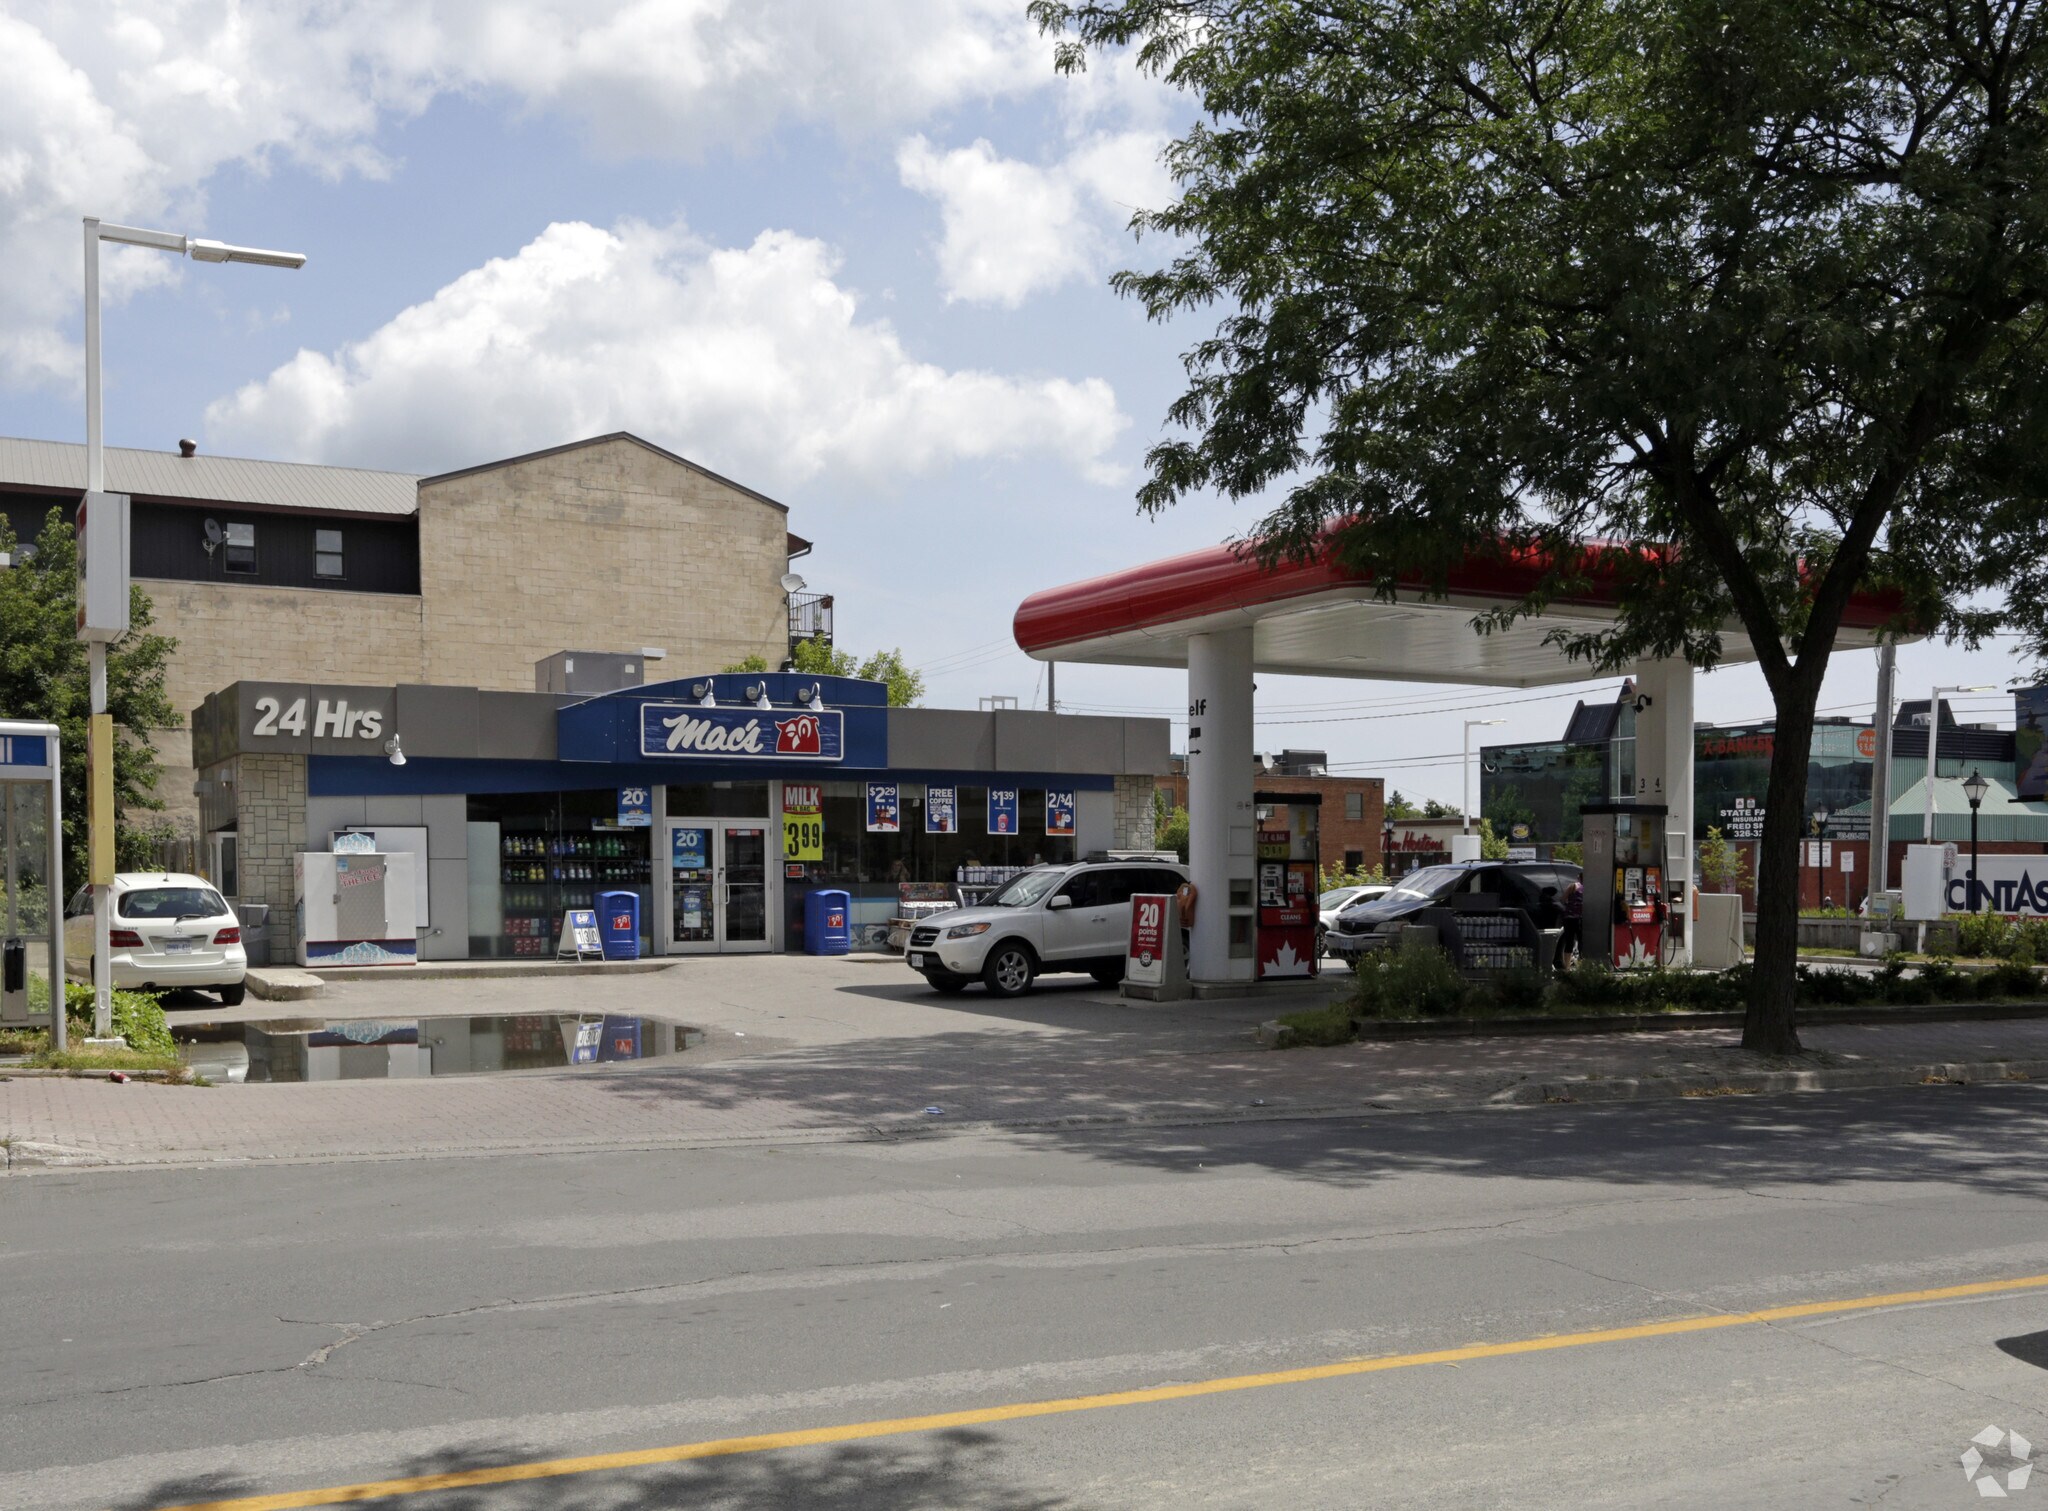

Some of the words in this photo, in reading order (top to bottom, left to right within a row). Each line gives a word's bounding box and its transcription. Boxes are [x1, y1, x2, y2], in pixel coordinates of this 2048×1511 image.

[253, 696, 307, 737] 24
[313, 699, 383, 739] Hrs
[662, 713, 764, 753] Mac's
[1641, 777, 1646, 789] 3
[1655, 777, 1660, 788] 4
[785, 786, 819, 806] MILK
[929, 788, 953, 798] FREE
[1048, 792, 1073, 809] 2/$4
[1720, 809, 1751, 817] STATE
[1139, 903, 1159, 928] 20
[1138, 928, 1158, 936] points
